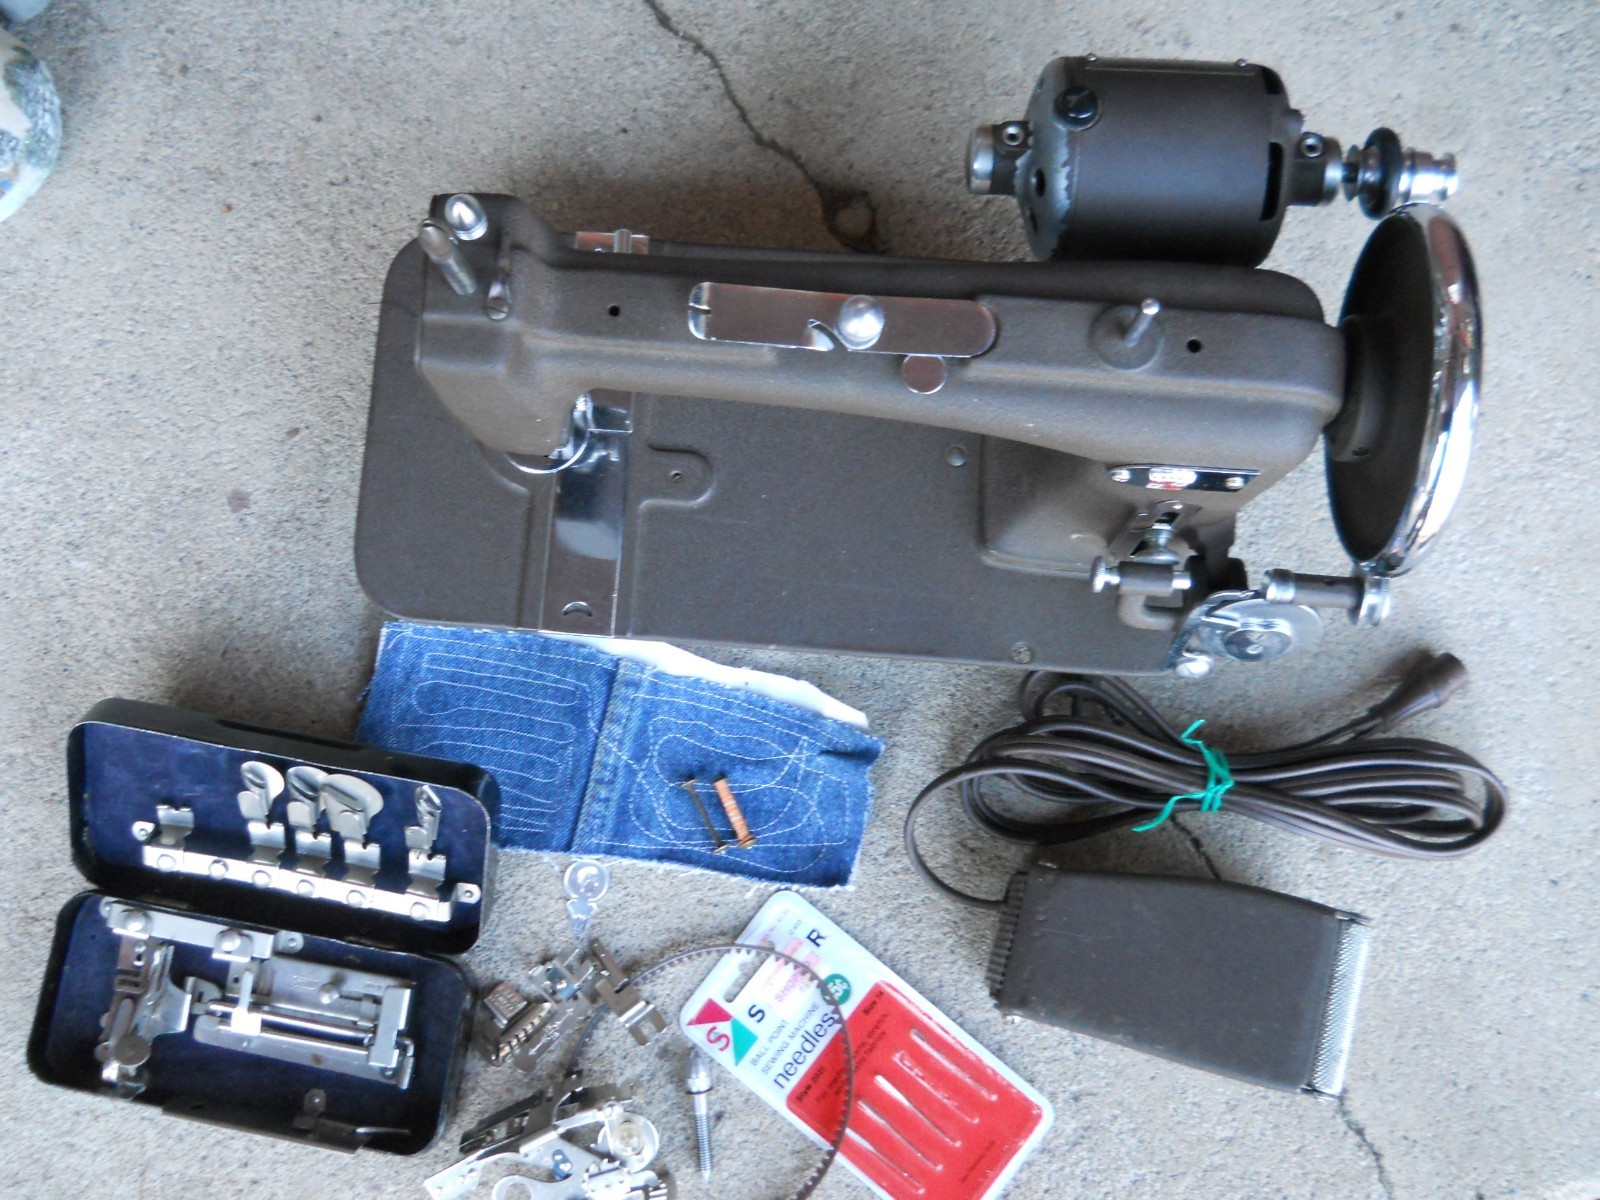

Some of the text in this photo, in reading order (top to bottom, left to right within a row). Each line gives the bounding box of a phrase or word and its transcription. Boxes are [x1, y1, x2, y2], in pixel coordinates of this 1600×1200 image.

[750, 1018, 789, 1067] BALL POINT
[761, 1040, 790, 1076] SEWING
[788, 1002, 820, 1042] MACHINE
[773, 1012, 837, 1089] needles
